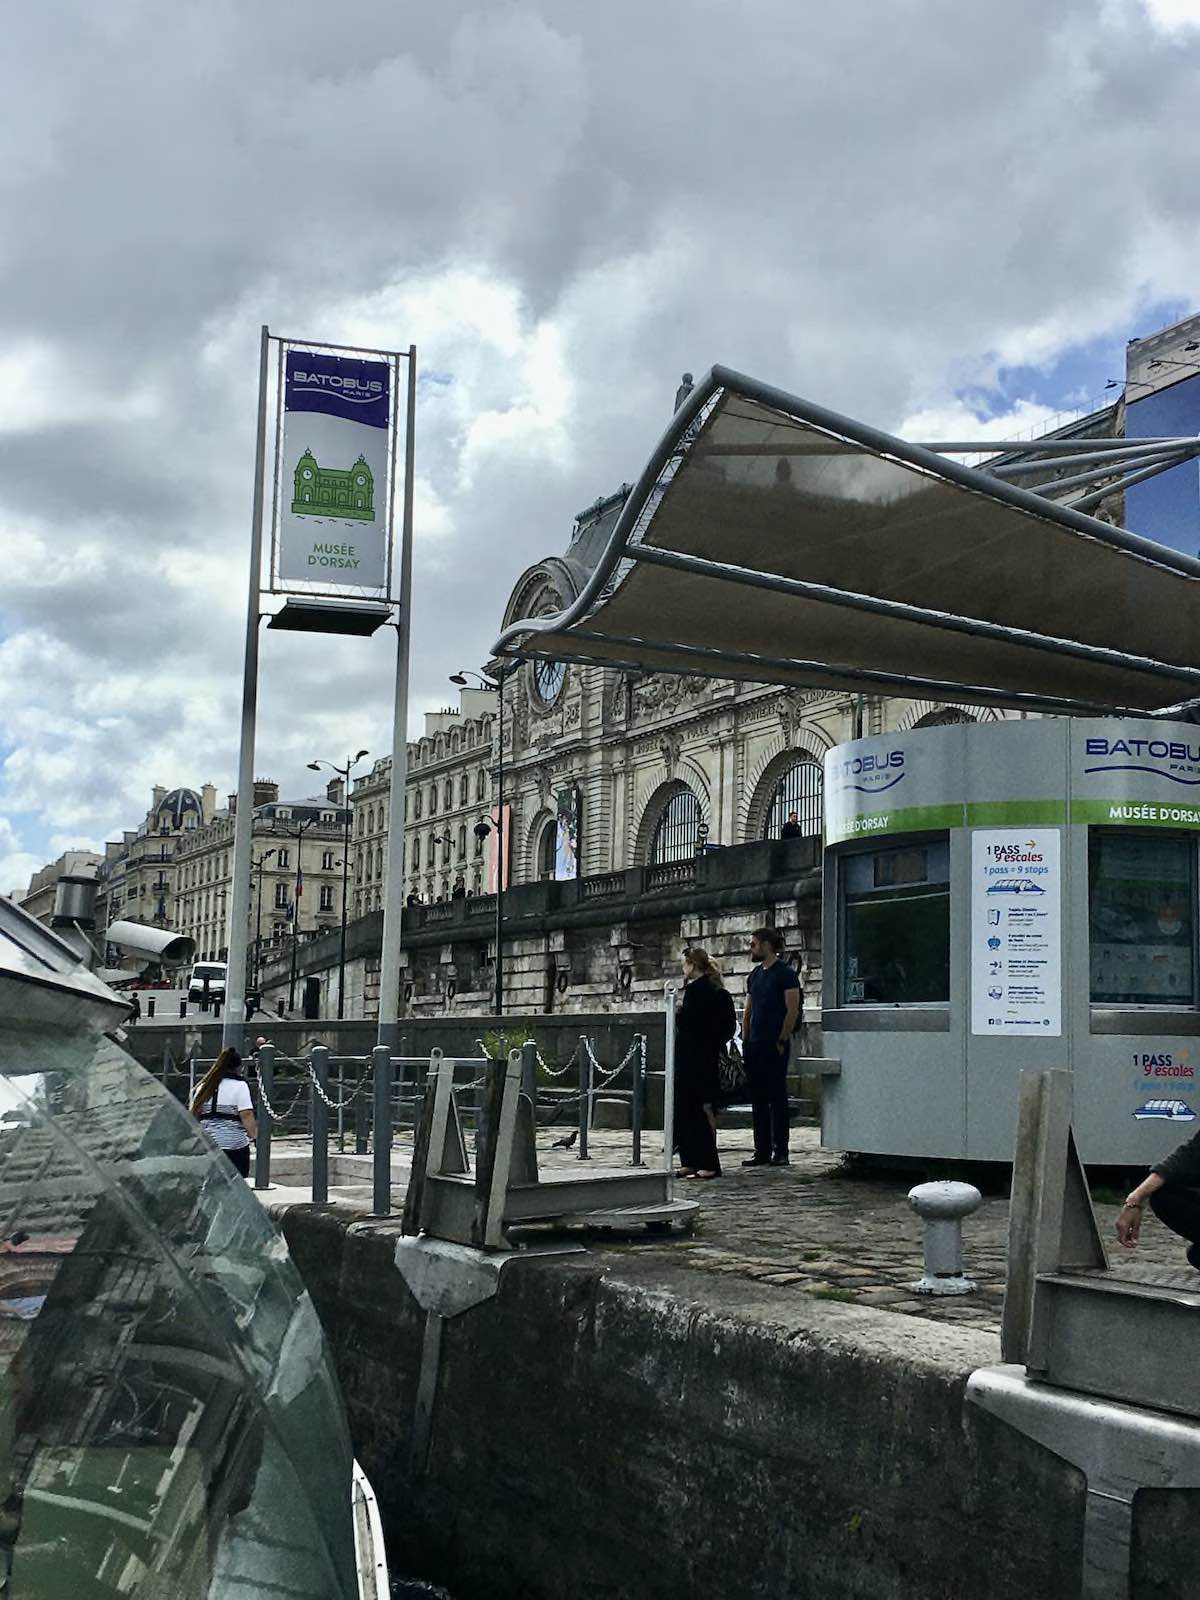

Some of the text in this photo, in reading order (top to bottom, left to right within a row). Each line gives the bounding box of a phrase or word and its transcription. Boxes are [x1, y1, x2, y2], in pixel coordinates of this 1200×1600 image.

[293, 371, 383, 392] BATOBUS
[343, 389, 371, 398] PARIS
[313, 542, 355, 556] MUSÉE
[308, 555, 361, 569] D'ORSAY
[1086, 739, 1200, 762] BATOBU
[1109, 804, 1157, 820] MUSÉE
[856, 816, 889, 832] D'ORSAY
[987, 845, 1020, 855] 1 PASS
[995, 852, 1043, 863] 9 escales
[989, 867, 1009, 875] pass
[1018, 866, 1023, 874] 9
[1025, 866, 1049, 875] stops
[1133, 1054, 1172, 1066] 1 PASS
[1144, 1064, 1195, 1077] 9 escales
